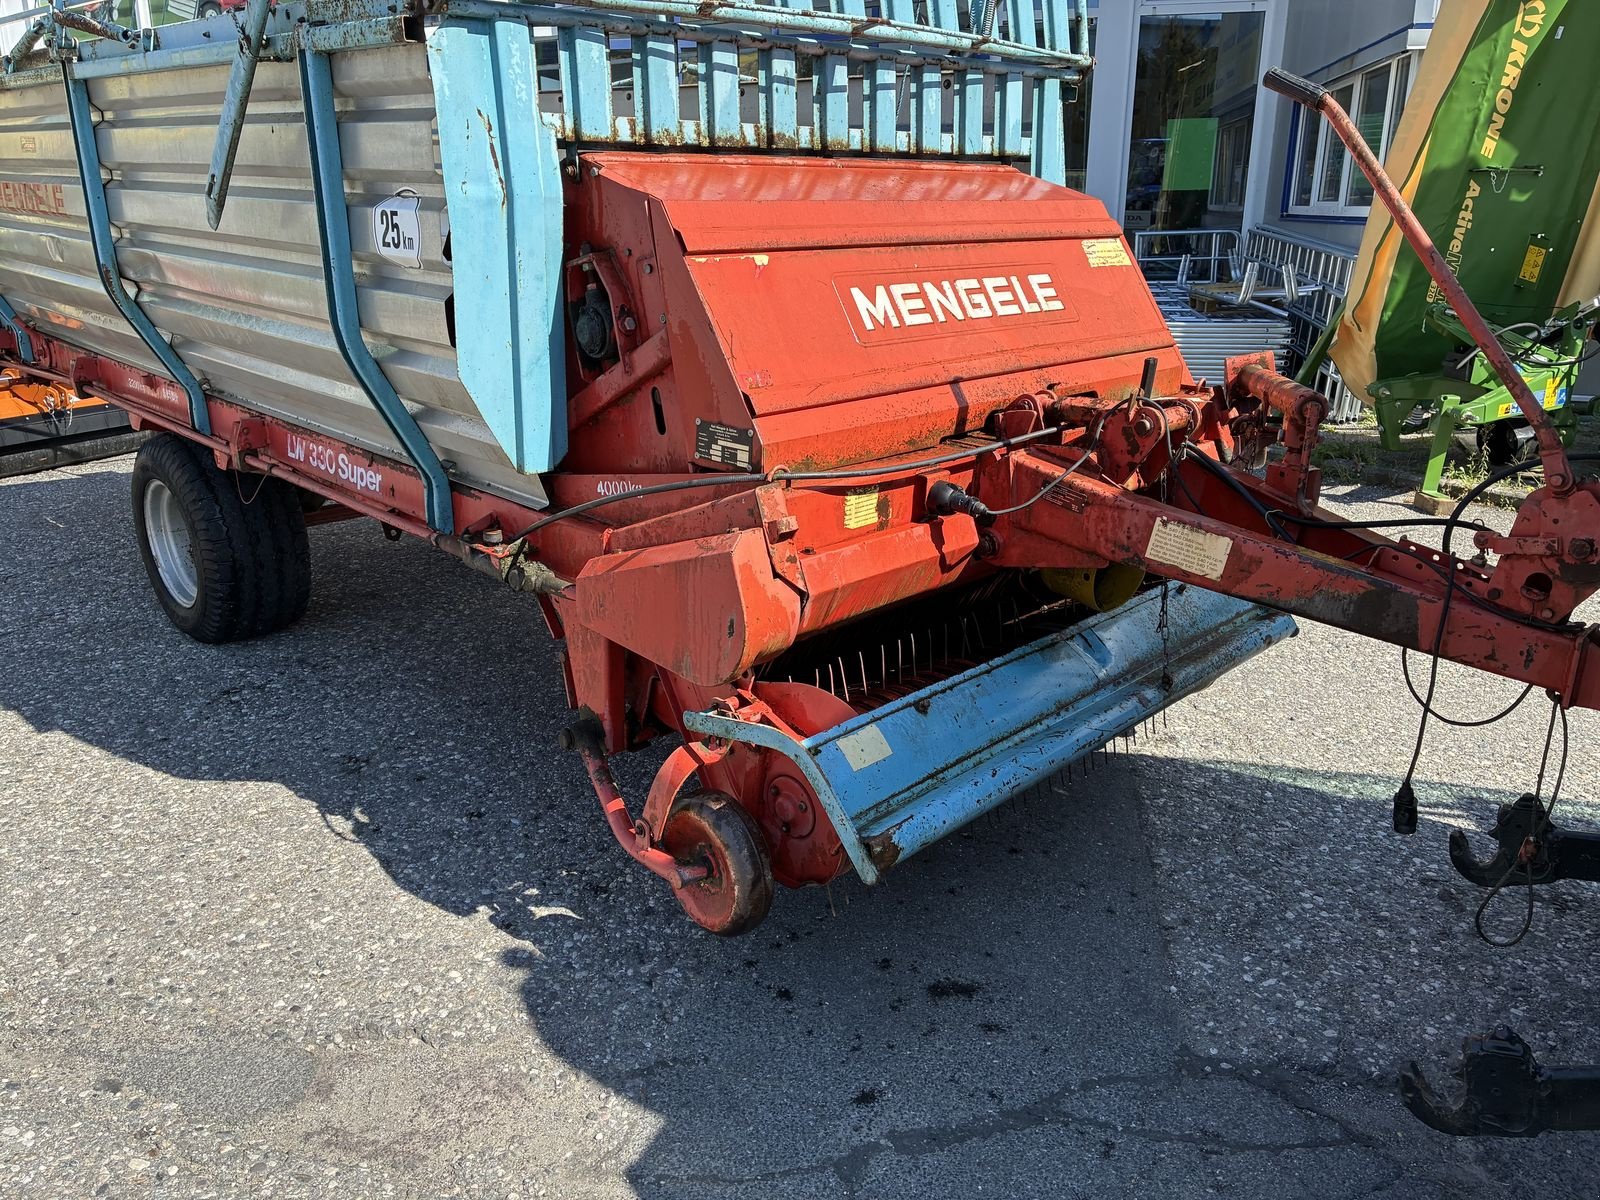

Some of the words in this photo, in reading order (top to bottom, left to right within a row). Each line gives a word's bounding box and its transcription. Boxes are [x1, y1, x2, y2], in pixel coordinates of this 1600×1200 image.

[1480, 38, 1529, 159] KRONE
[380, 209, 401, 250] 25
[402, 231, 415, 250] km
[850, 274, 1065, 331] MENGELE
[287, 433, 306, 462] LW
[309, 442, 336, 475] 330
[338, 453, 382, 492] Super
